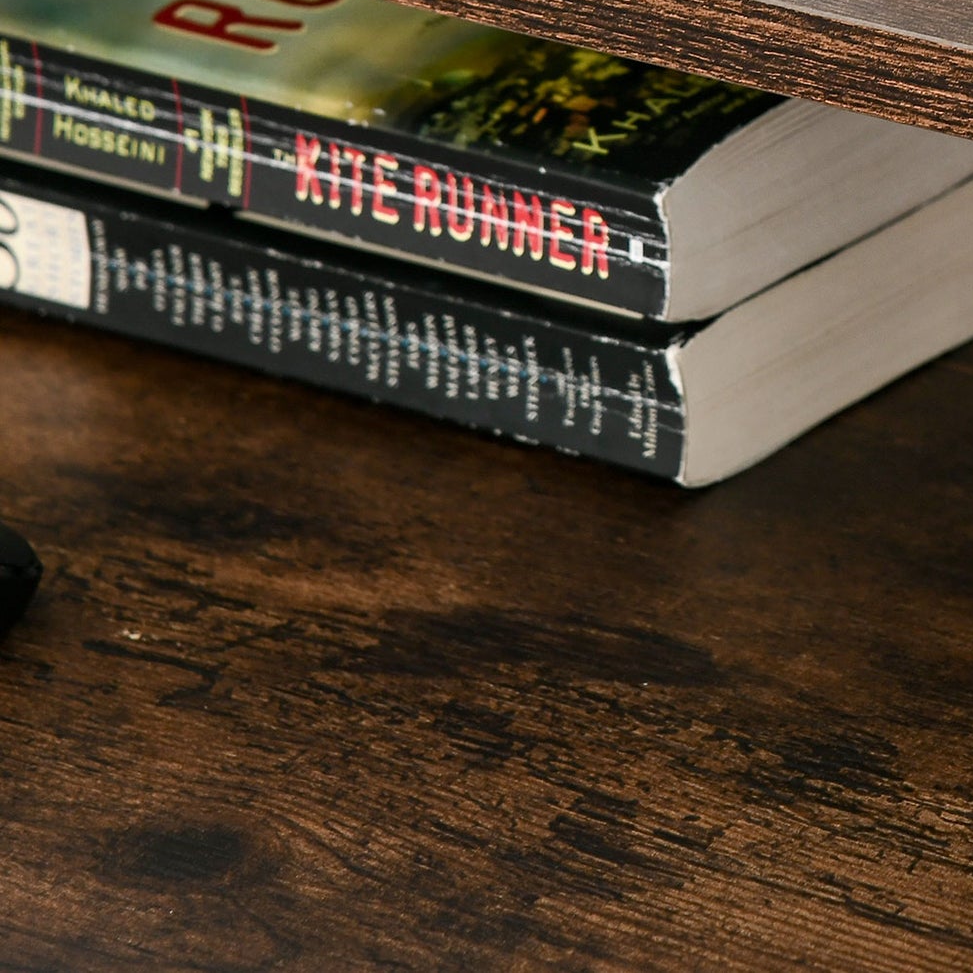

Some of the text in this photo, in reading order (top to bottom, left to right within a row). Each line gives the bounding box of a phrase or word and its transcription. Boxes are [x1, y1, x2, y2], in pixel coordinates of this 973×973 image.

[64, 74, 156, 121] KHALED
[53, 112, 165, 164] HOSSEINI
[295, 132, 400, 225] KITE
[413, 164, 610, 279] RUNNER
